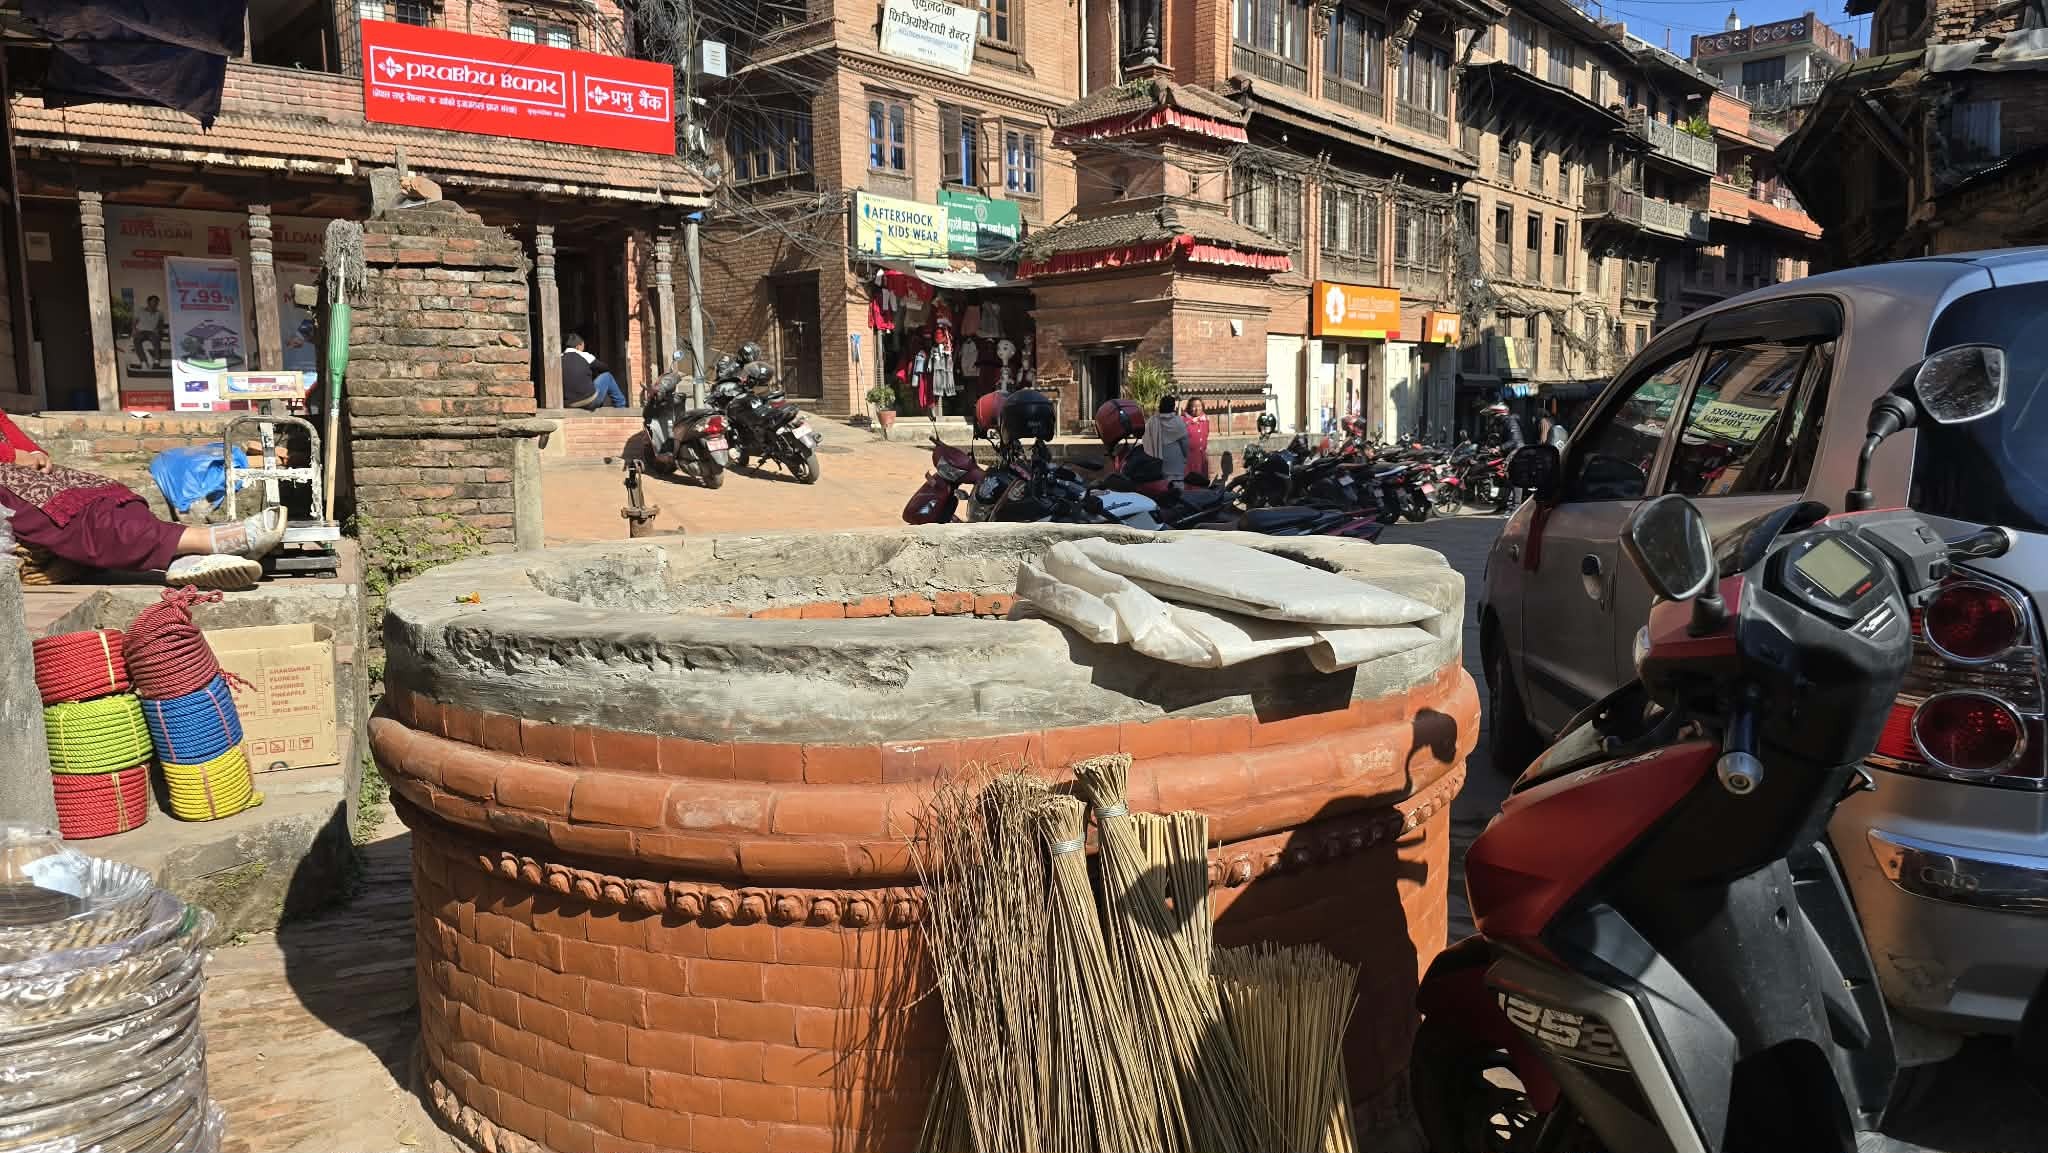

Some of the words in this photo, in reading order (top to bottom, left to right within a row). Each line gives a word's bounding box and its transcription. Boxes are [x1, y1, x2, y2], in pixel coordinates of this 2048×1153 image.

[610, 92, 633, 112] प्रभु
[639, 87, 662, 110] बैंक
[872, 207, 933, 227] AFTERSHOCK
[888, 225, 910, 238] KIDS
[912, 229, 938, 242] WEAR
[1498, 992, 1584, 1048] 125
